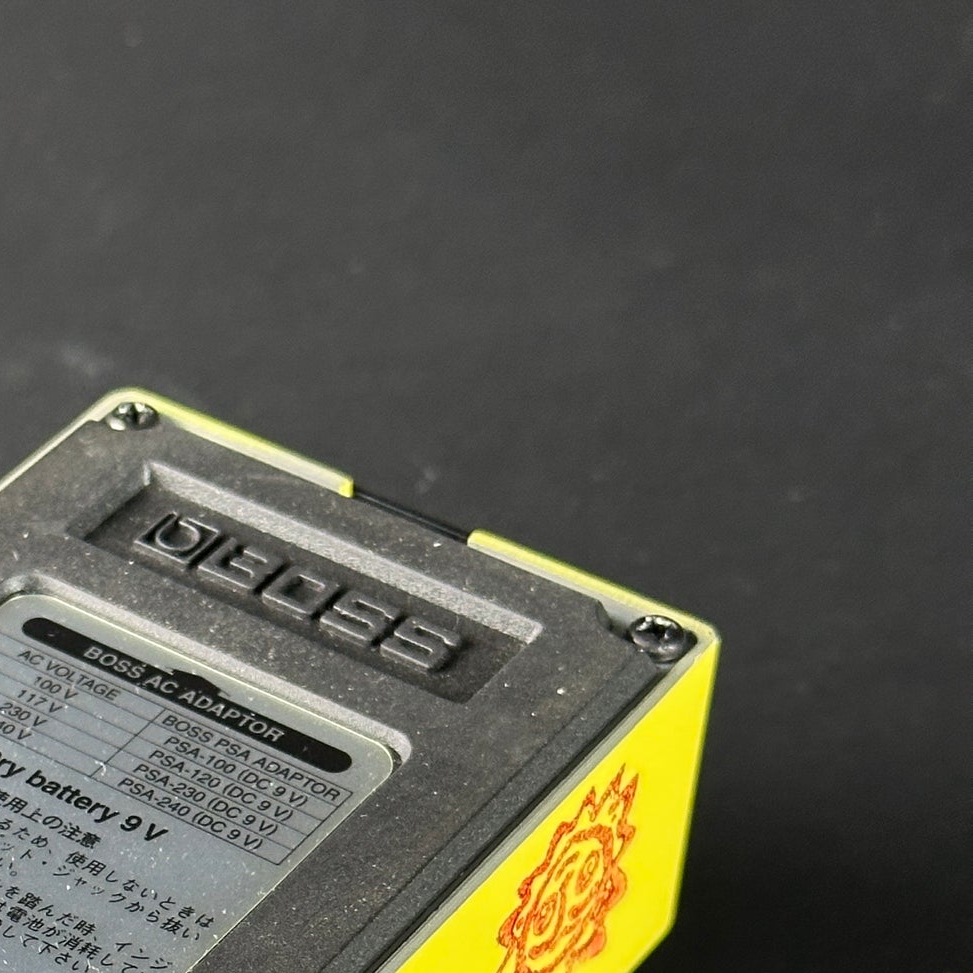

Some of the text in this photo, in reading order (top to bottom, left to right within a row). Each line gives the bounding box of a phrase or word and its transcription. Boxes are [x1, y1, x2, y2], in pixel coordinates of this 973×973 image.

[196, 537, 461, 670] BOSS
[17, 650, 122, 701] AC VOLTAGE
[17, 689, 63, 714] 117 V
[33, 676, 79, 701] 100 V
[83, 646, 285, 742] BOSS AC ADAPTOR
[17, 728, 32, 741] V
[32, 715, 48, 728] V
[161, 714, 341, 802] BOSS PSA ADAPTOR
[25, 769, 121, 824] battery
[119, 815, 143, 832] 9
[143, 822, 169, 842] V
[132, 763, 279, 837] PSA-230 (DC 9 V)
[148, 749, 294, 823] PSA-120 (DC 9 V)
[163, 735, 309, 809] PSA-100 (DC 9 V)
[117, 777, 264, 850] PSA-240 (DC 9 V)
